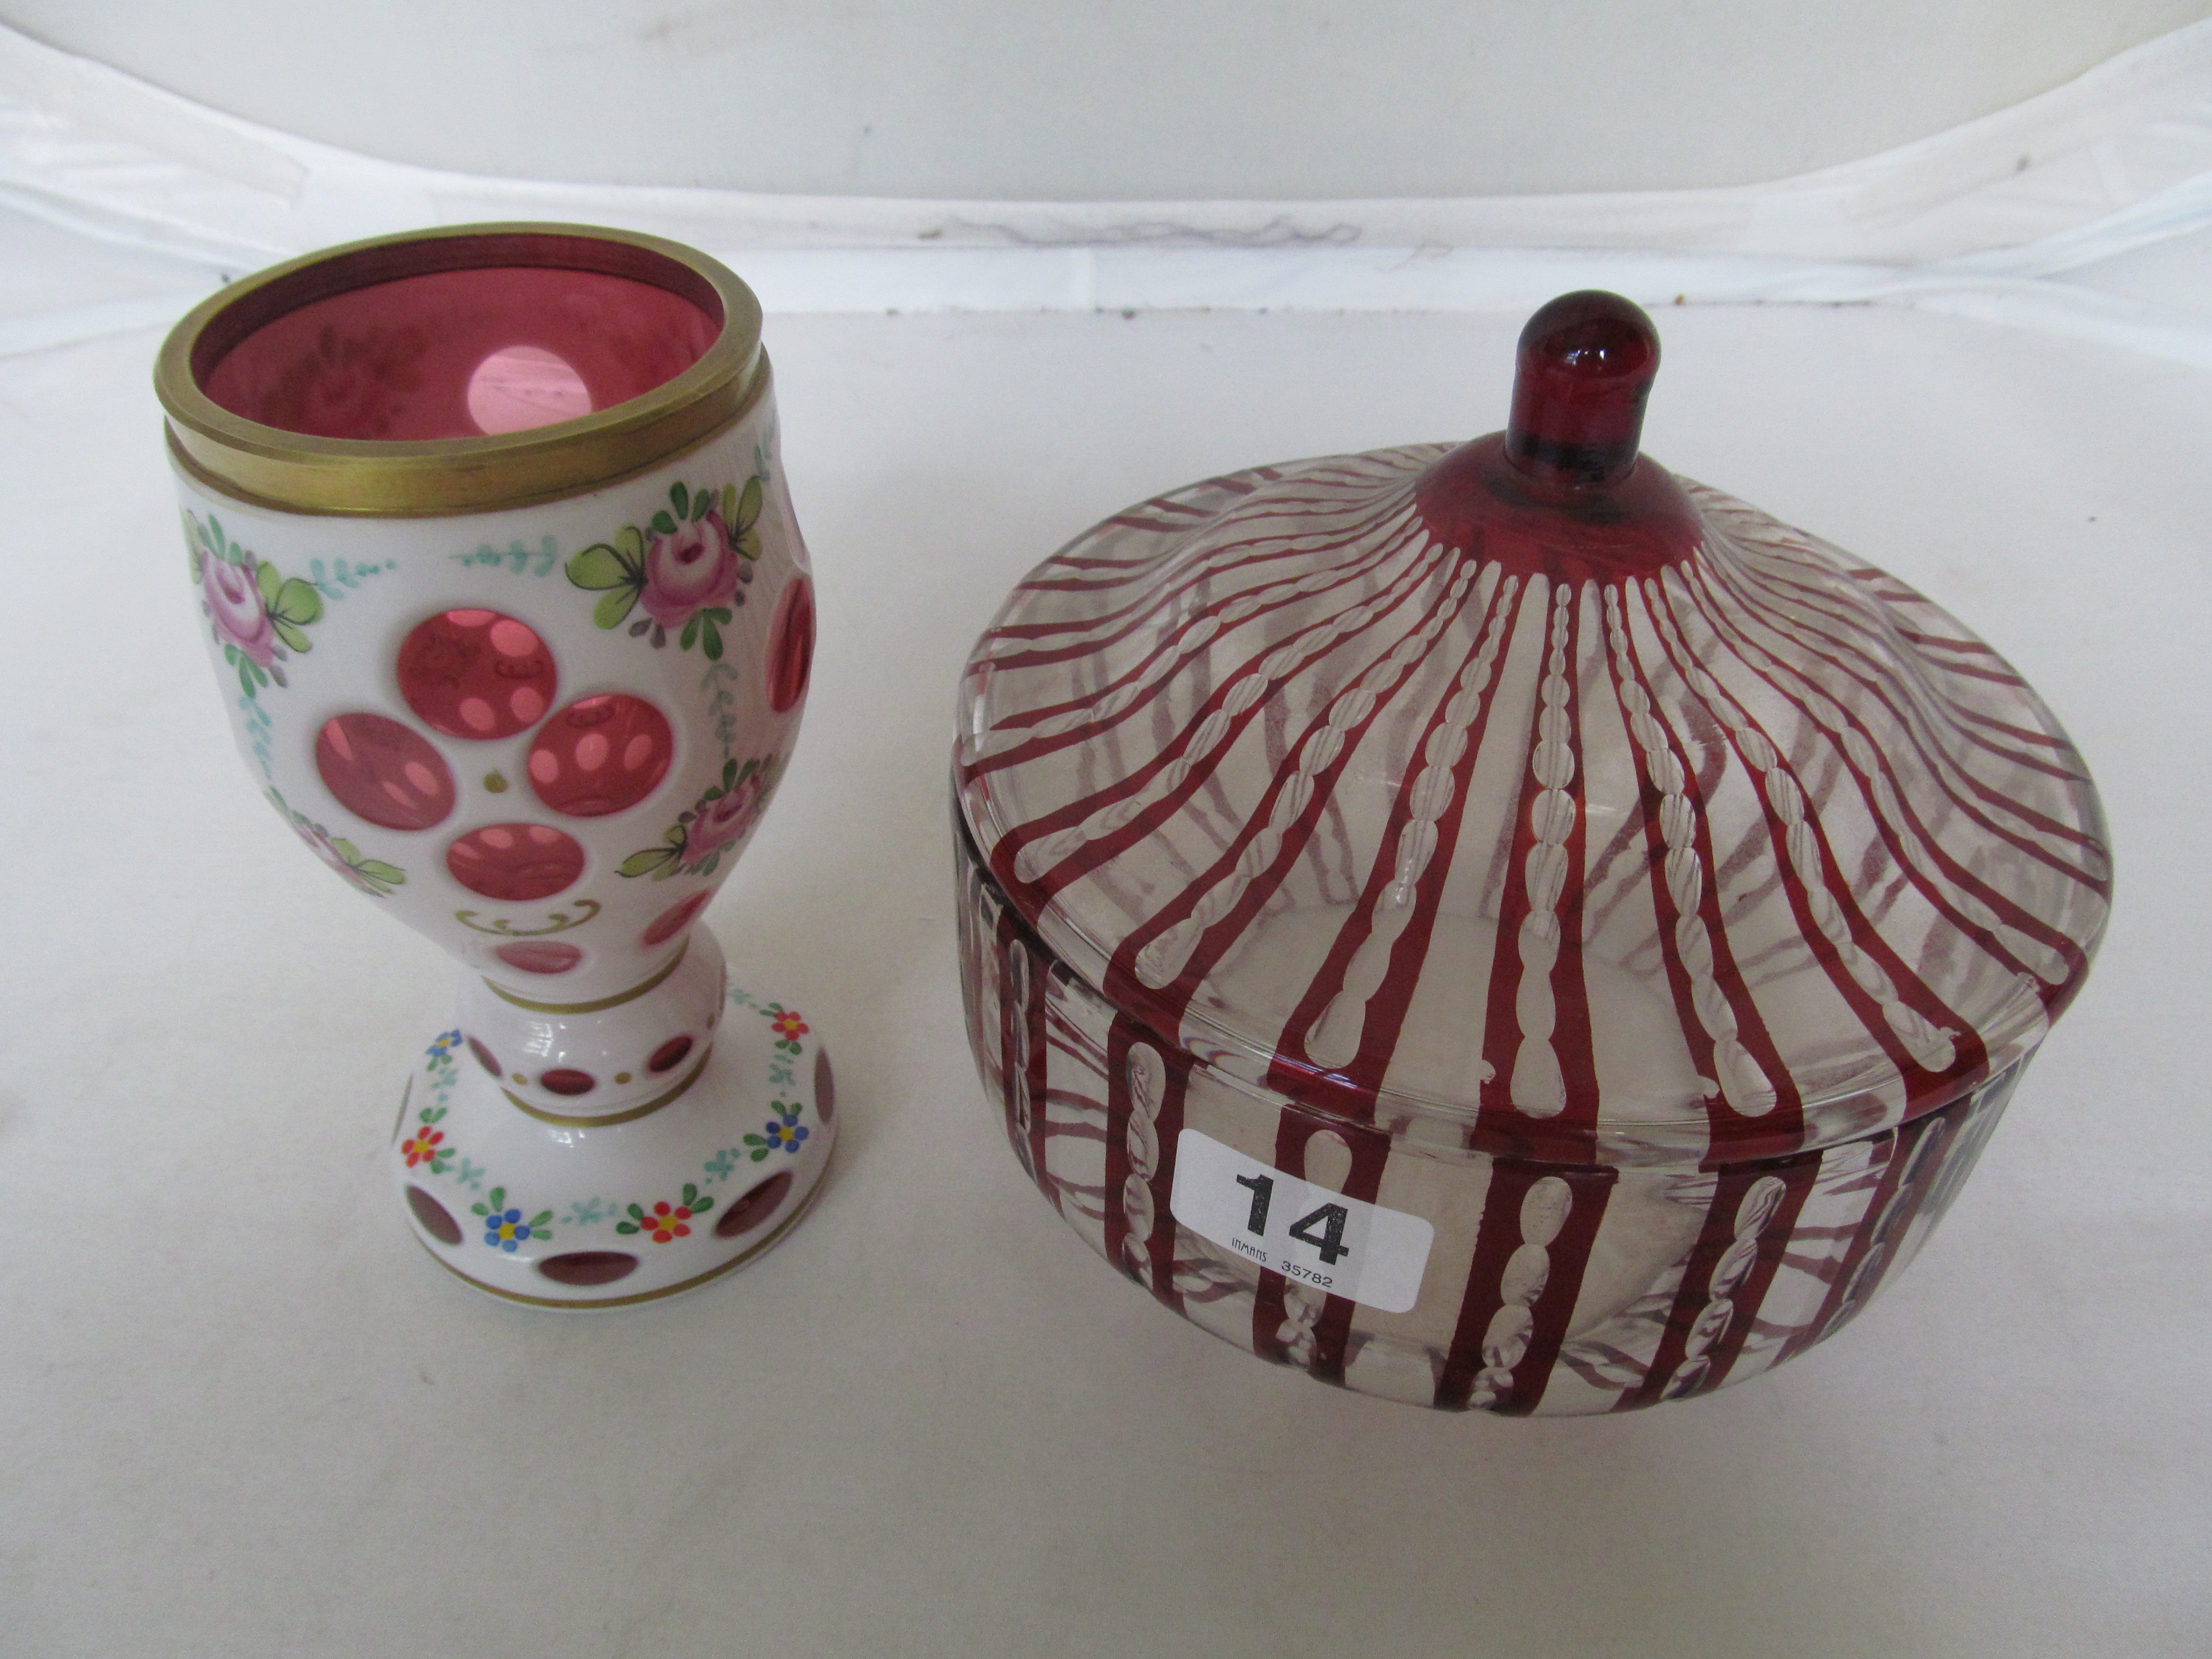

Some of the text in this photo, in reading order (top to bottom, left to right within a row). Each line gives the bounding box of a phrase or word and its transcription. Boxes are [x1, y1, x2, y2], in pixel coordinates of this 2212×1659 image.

[1236, 1174, 1349, 1265] 14
[1231, 1237, 1333, 1288] INMANS 35782
